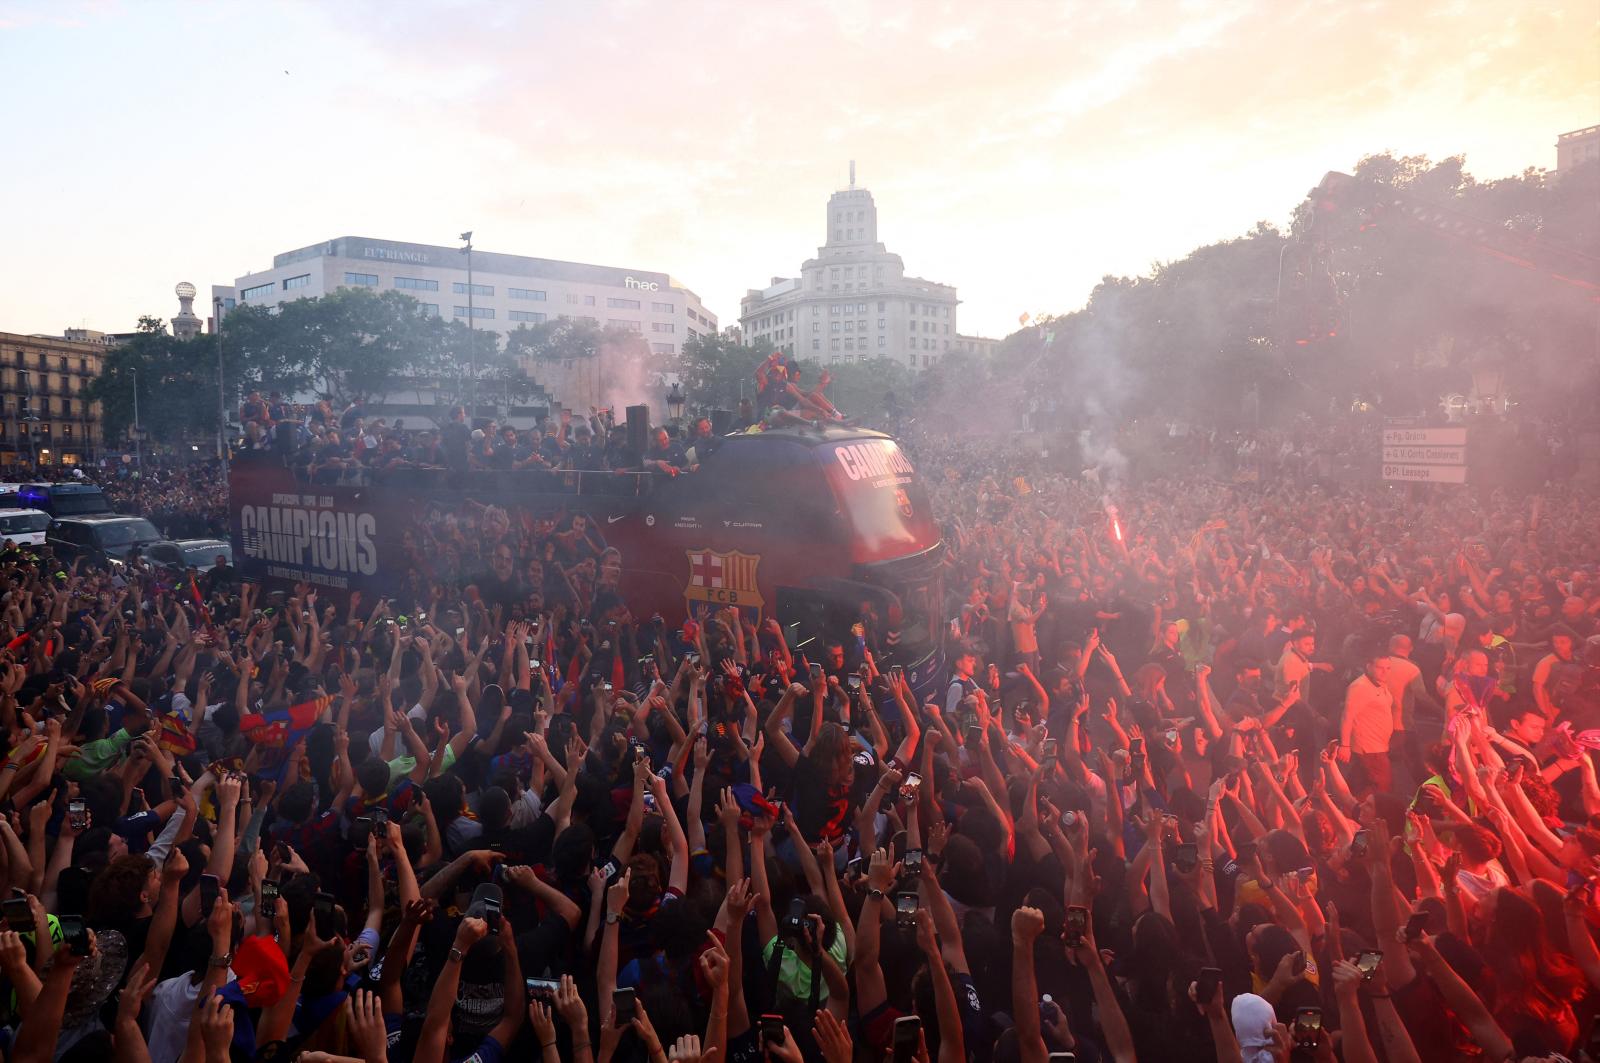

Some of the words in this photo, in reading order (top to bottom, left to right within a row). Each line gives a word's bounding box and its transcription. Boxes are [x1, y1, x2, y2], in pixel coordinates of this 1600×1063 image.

[625, 276, 659, 292] fnac
[241, 504, 377, 576] CAMPIONS
[707, 588, 737, 602] FCB
